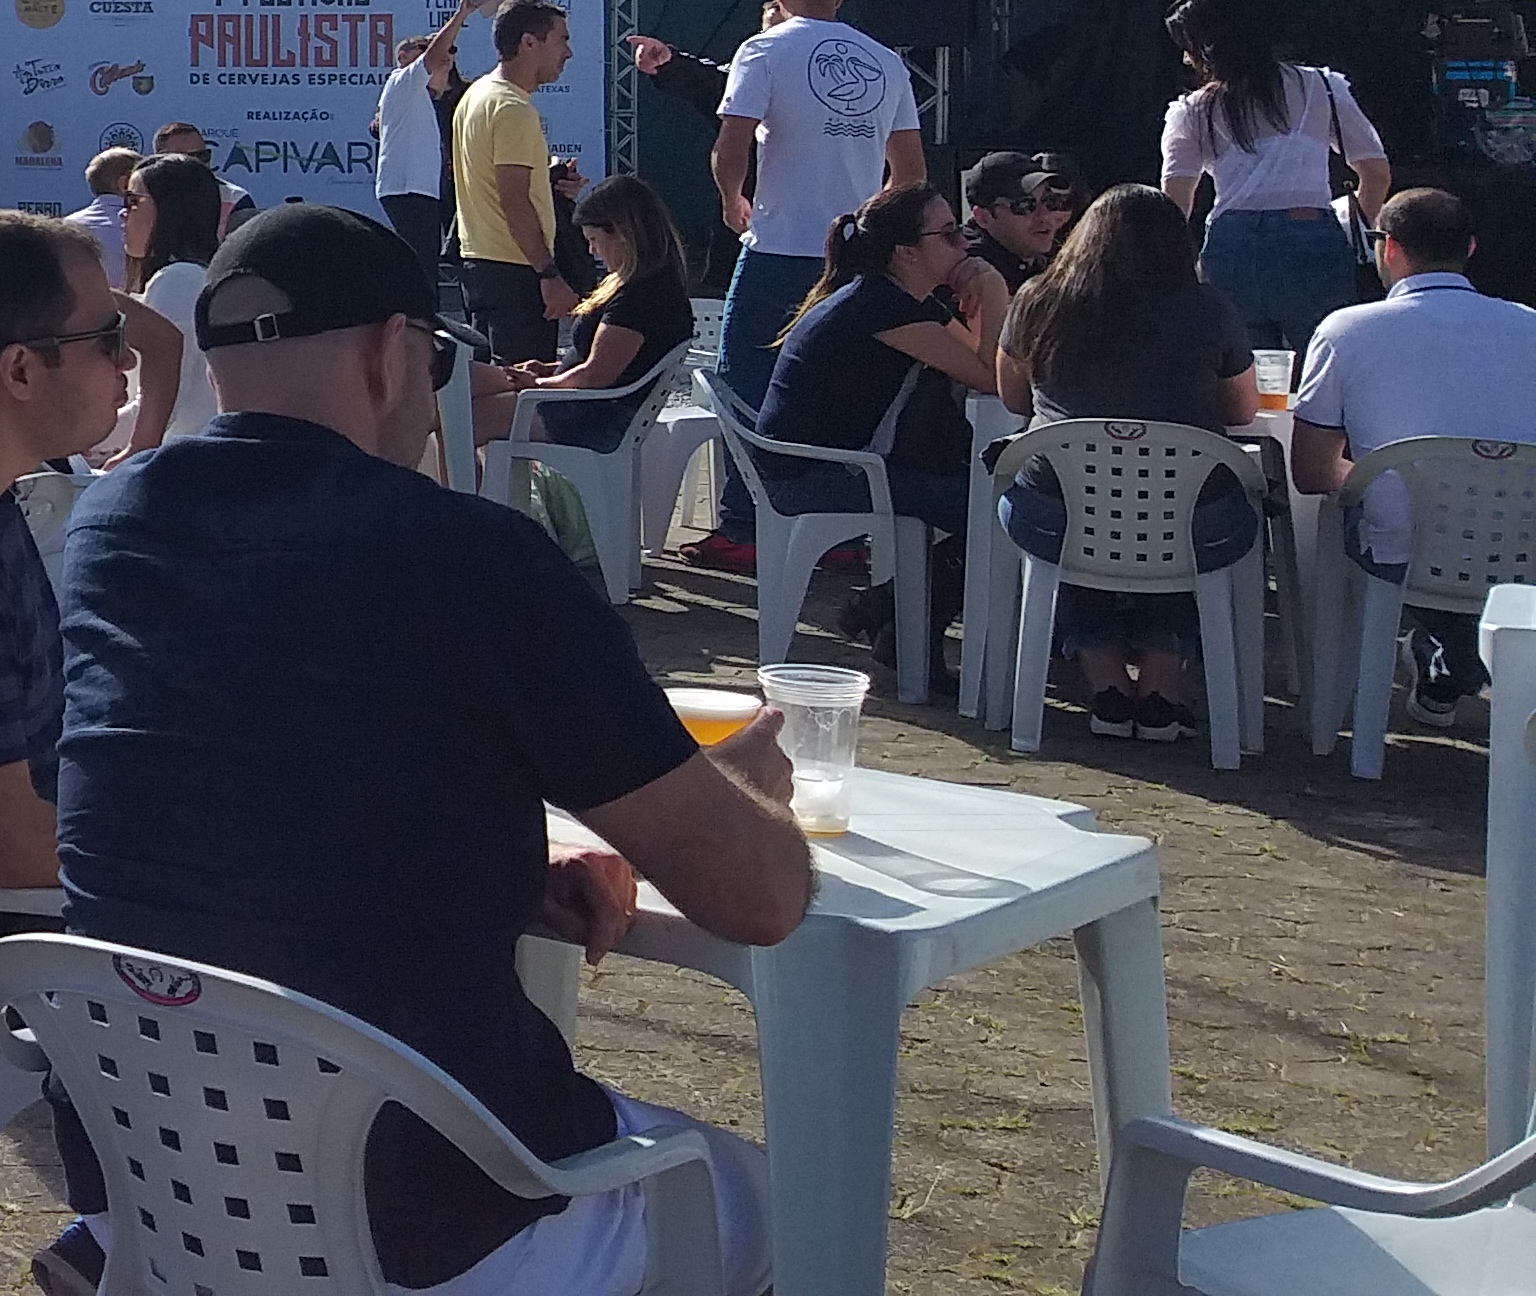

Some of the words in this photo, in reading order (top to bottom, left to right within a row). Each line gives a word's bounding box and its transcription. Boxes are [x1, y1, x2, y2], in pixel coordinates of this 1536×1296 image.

[89, 1, 154, 14] CUESTA
[429, 11, 469, 28] LIB
[189, 14, 394, 68] PAULISTA
[190, 73, 210, 85] DE
[217, 73, 301, 85] CERVEJAS
[535, 85, 570, 93] ATEXAS
[201, 128, 239, 138] ARQUE
[548, 144, 581, 153] ADEN
